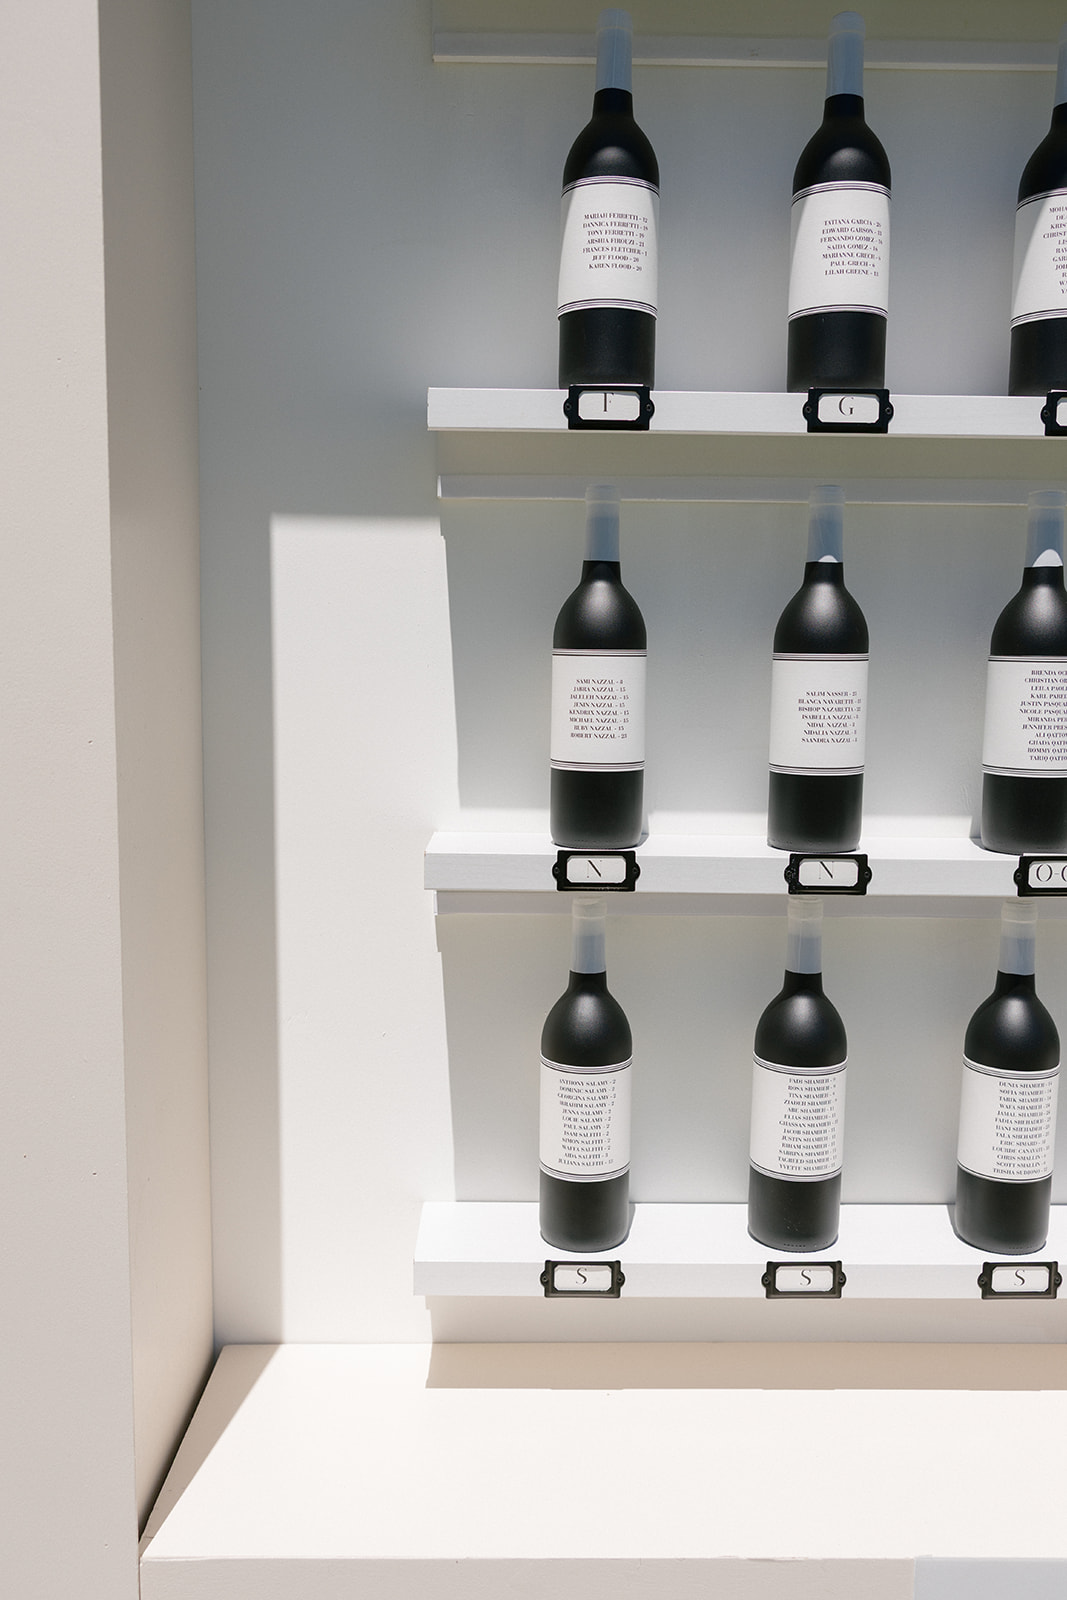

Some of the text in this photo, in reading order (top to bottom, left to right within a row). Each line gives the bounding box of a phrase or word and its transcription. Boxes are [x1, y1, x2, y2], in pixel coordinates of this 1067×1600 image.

[609, 213, 638, 221] FERRETTI
[582, 246, 641, 255] FRANCES FLETCHER
[822, 252, 854, 260] MARIANNE
[603, 392, 615, 413] F
[838, 396, 855, 417] G
[587, 859, 603, 878] N
[819, 861, 835, 879] N
[1036, 863, 1067, 882] O-
[557, 1093, 586, 1101] GEORGINA
[584, 1101, 607, 1109] SALAMY
[575, 1268, 587, 1284] S
[800, 1269, 811, 1286] S
[1014, 1270, 1026, 1286] S
